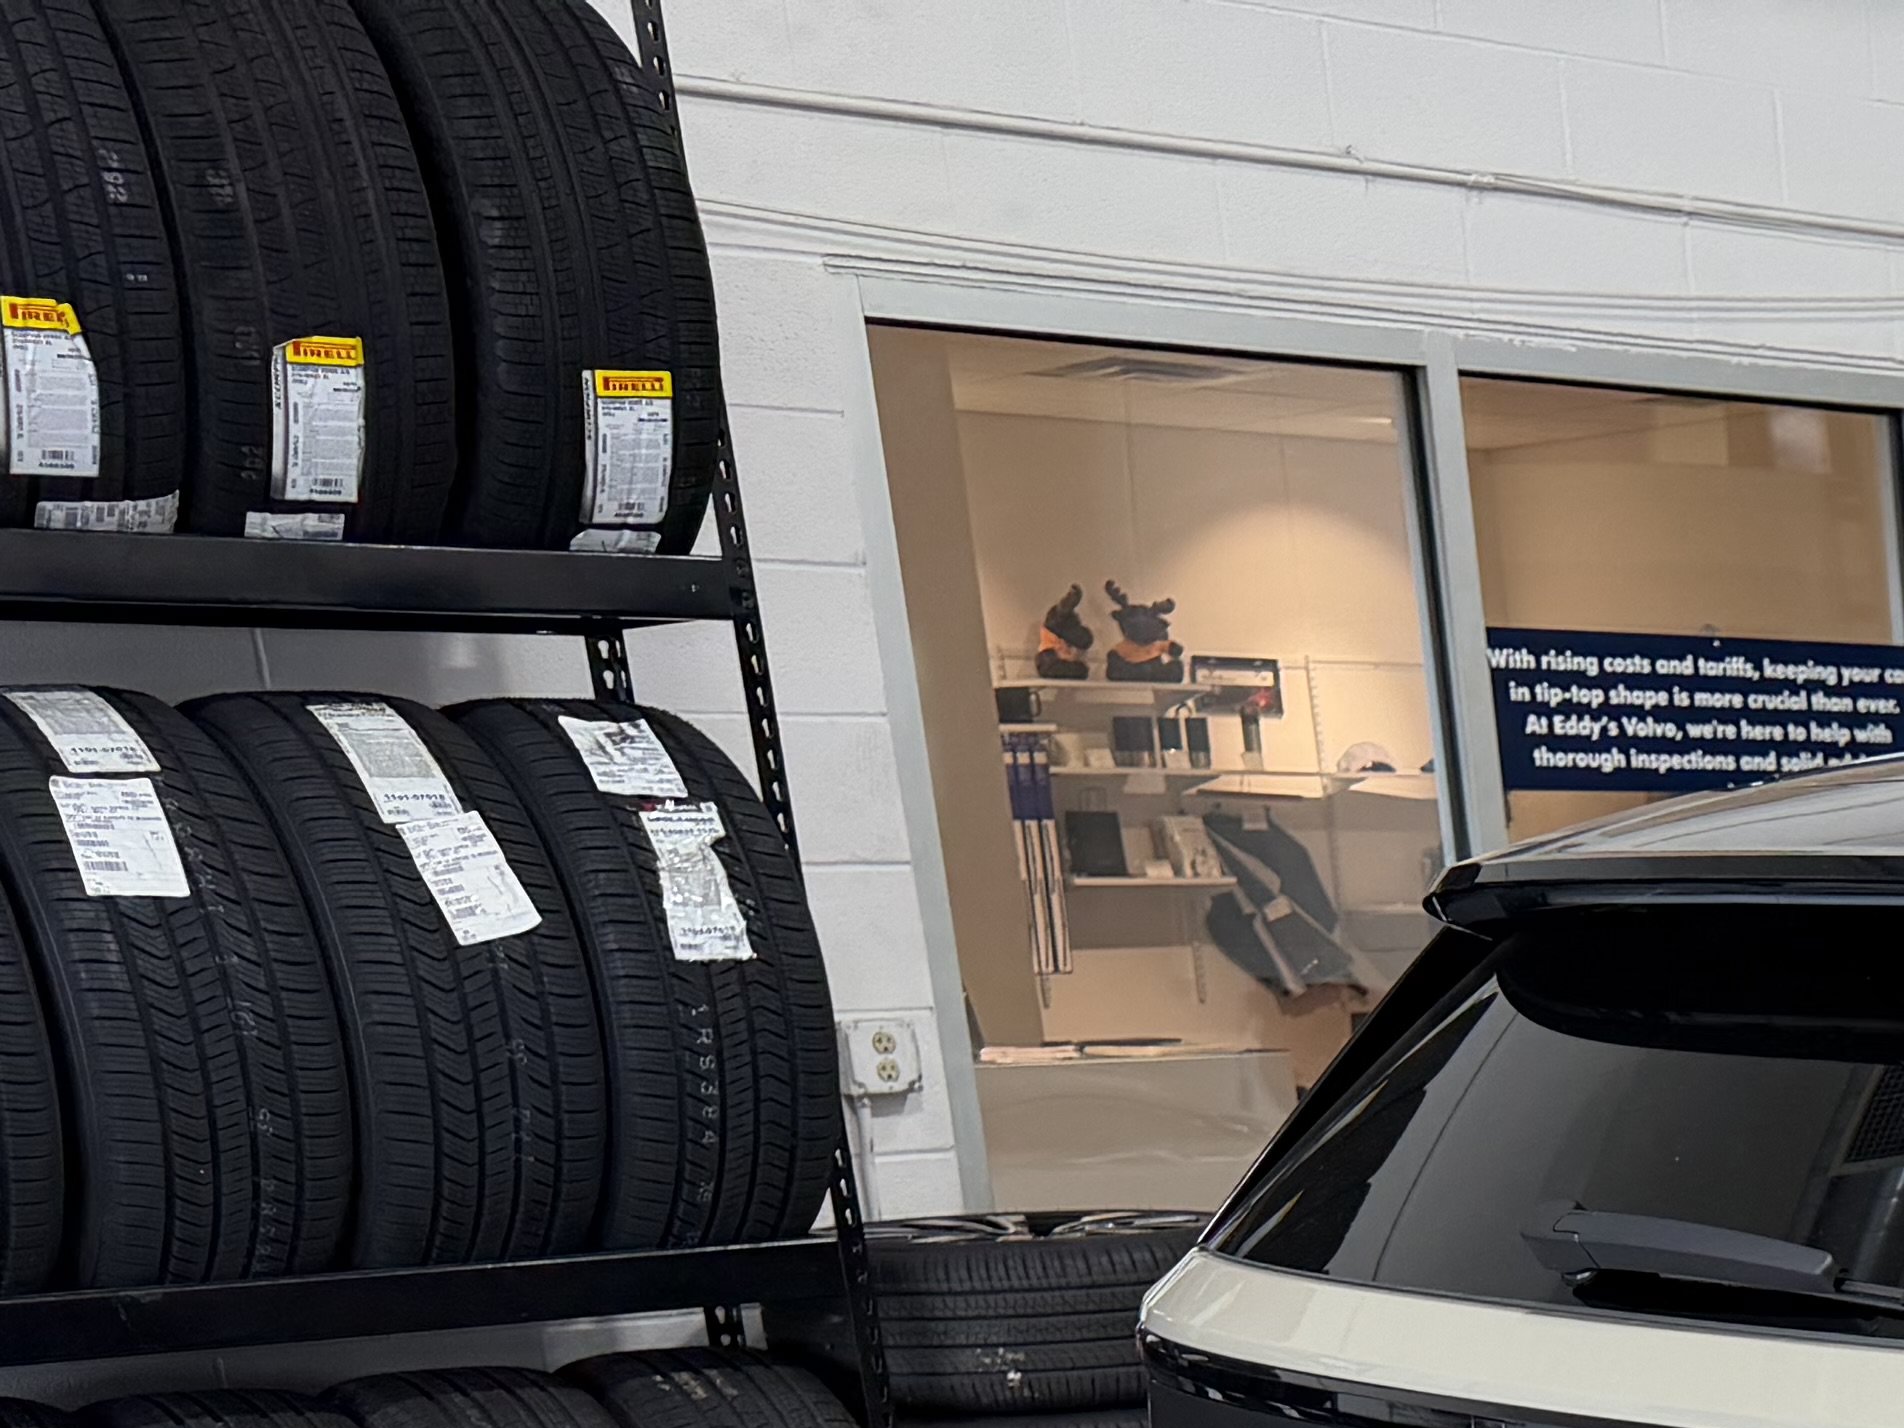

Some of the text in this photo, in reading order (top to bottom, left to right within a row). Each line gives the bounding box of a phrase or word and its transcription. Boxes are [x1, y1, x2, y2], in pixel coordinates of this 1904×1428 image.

[602, 375, 664, 392] PIRELLI
[1488, 648, 1536, 669] With
[1541, 649, 1599, 676] rising
[1603, 655, 1651, 674] costs
[1655, 654, 1694, 676] and
[1698, 656, 1760, 681] tariffs,
[1763, 658, 1838, 686] keeping
[1840, 667, 1882, 686] your
[1509, 681, 1900, 714] in tip-top shape is more crucial than ever.
[1525, 714, 1893, 747] At Eddy's Volvo, we're here to help with
[1533, 746, 1626, 773] thorough
[1630, 748, 1737, 774] inspections
[1740, 751, 1777, 771] and
[1780, 752, 1824, 772] solid
